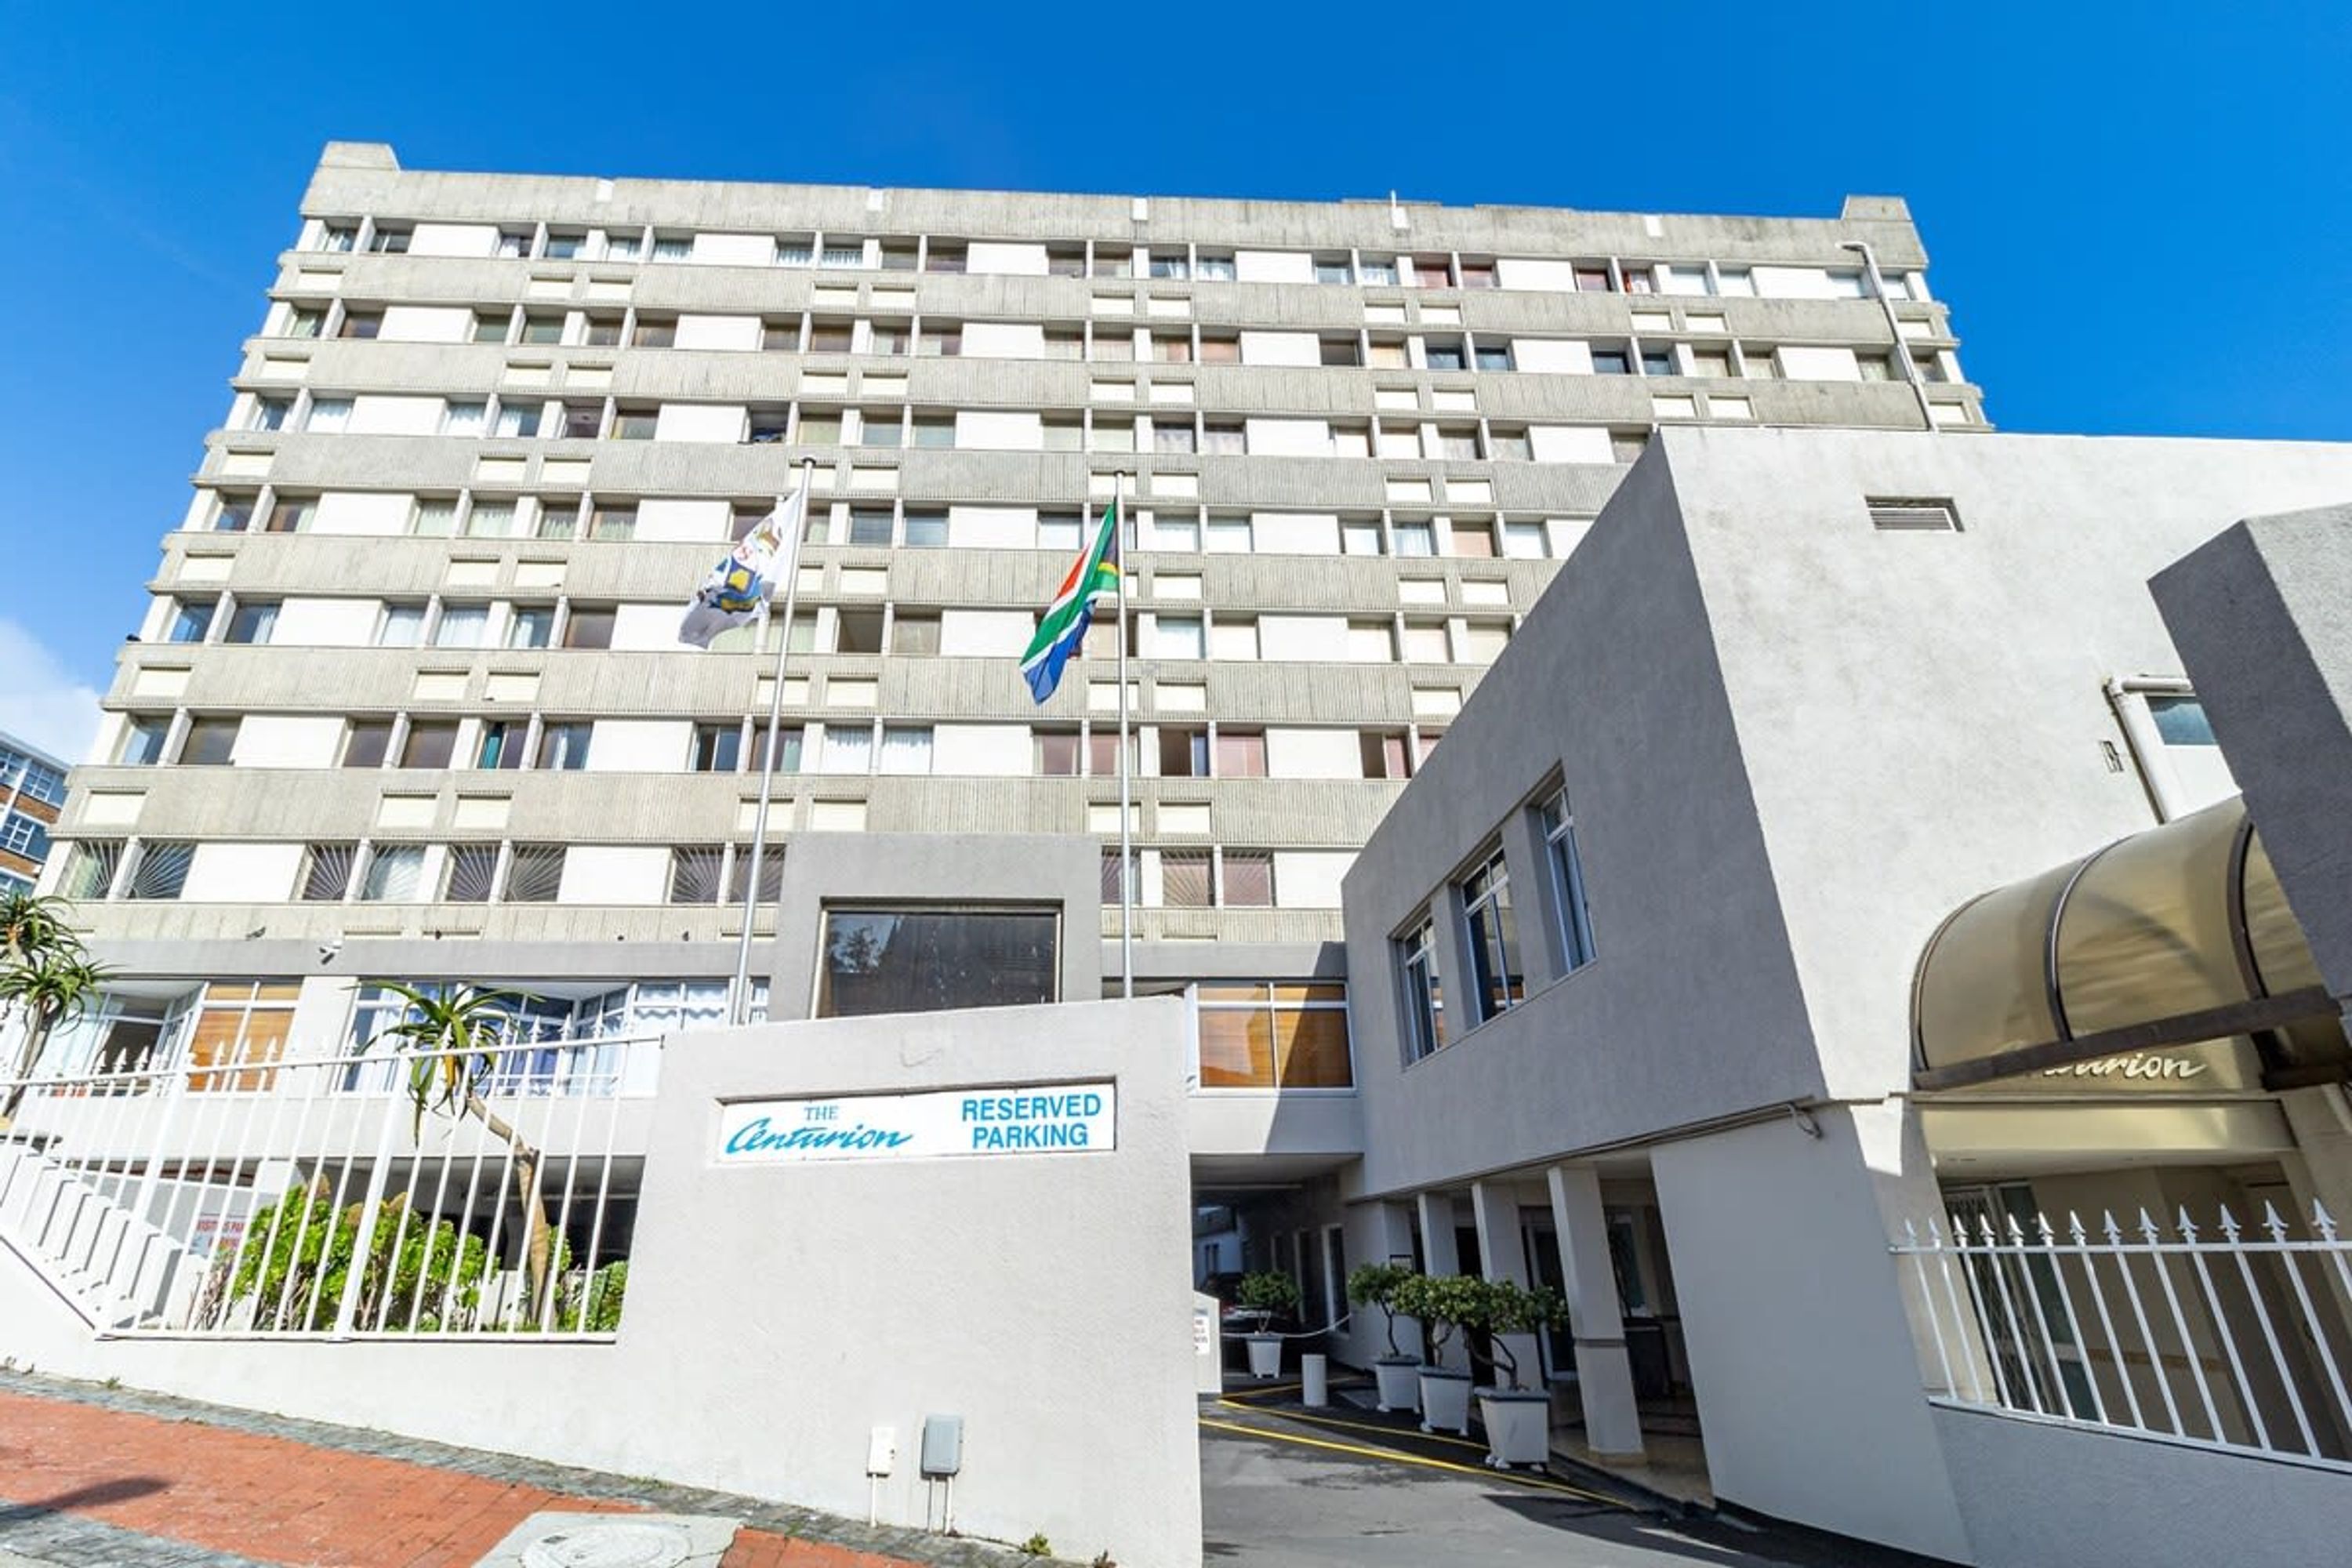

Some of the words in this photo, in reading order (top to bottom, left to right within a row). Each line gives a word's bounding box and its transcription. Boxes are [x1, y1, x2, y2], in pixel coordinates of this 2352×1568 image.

[804, 1105, 839, 1121] THE
[962, 1094, 1101, 1121] RESERVED
[726, 1117, 913, 1154] Centurion
[973, 1123, 1088, 1149] PARKING
